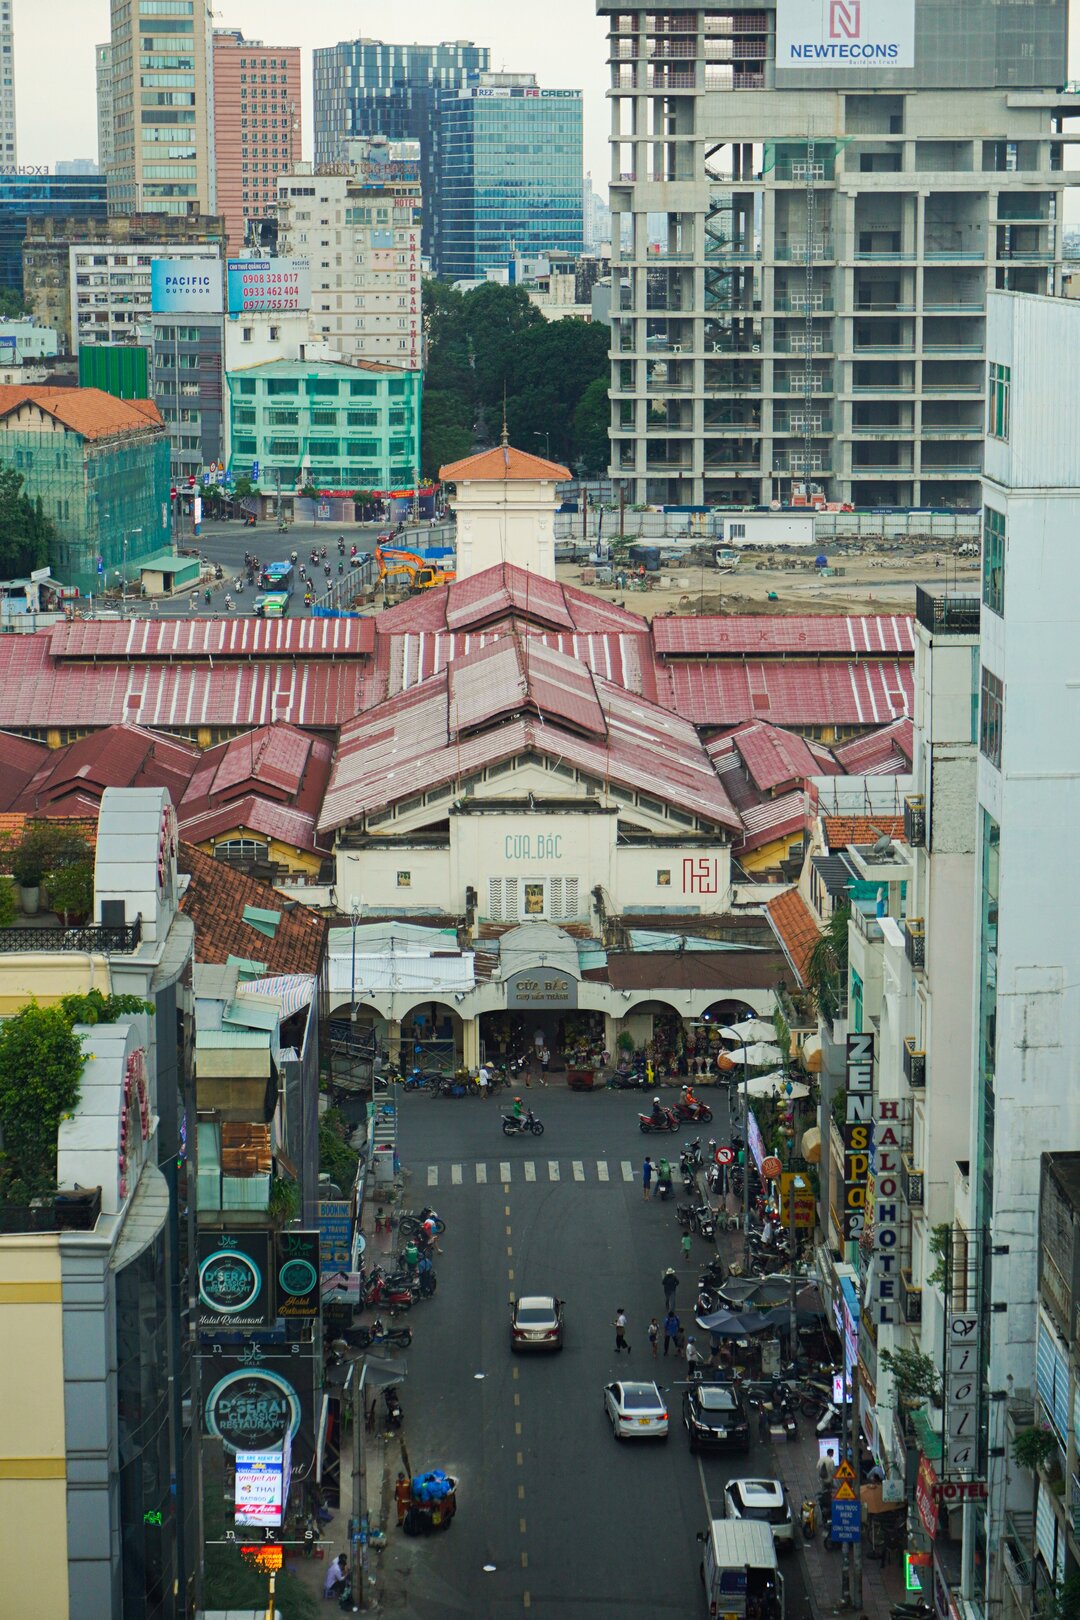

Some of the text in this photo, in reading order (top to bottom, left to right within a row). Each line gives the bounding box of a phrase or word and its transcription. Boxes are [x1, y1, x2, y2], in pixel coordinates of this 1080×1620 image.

[790, 44, 898, 58] NEWTECONS
[526, 89, 582, 98] FE CREDIT
[394, 198, 418, 207] HOTEL
[165, 277, 210, 285] PACIFIC
[243, 273, 298, 283] 0908 328 017
[243, 286, 299, 296] 0933 462 404
[243, 298, 298, 309] 0977 755 751
[544, 976, 569, 991] BẮC
[848, 1035, 872, 1121] ZEN
[878, 1101, 899, 1324] HALO HOTEL
[849, 1213, 865, 1241] 2
[284, 1296, 310, 1306] Halal
[278, 1306, 318, 1316] Restaurant
[199, 1314, 264, 1326] Halal Restaurant
[219, 1400, 287, 1414] D'SERAI
[228, 1413, 278, 1421] CLASSIC
[220, 1420, 285, 1429] RESTAURANT
[932, 1484, 989, 1499] HOTEL
